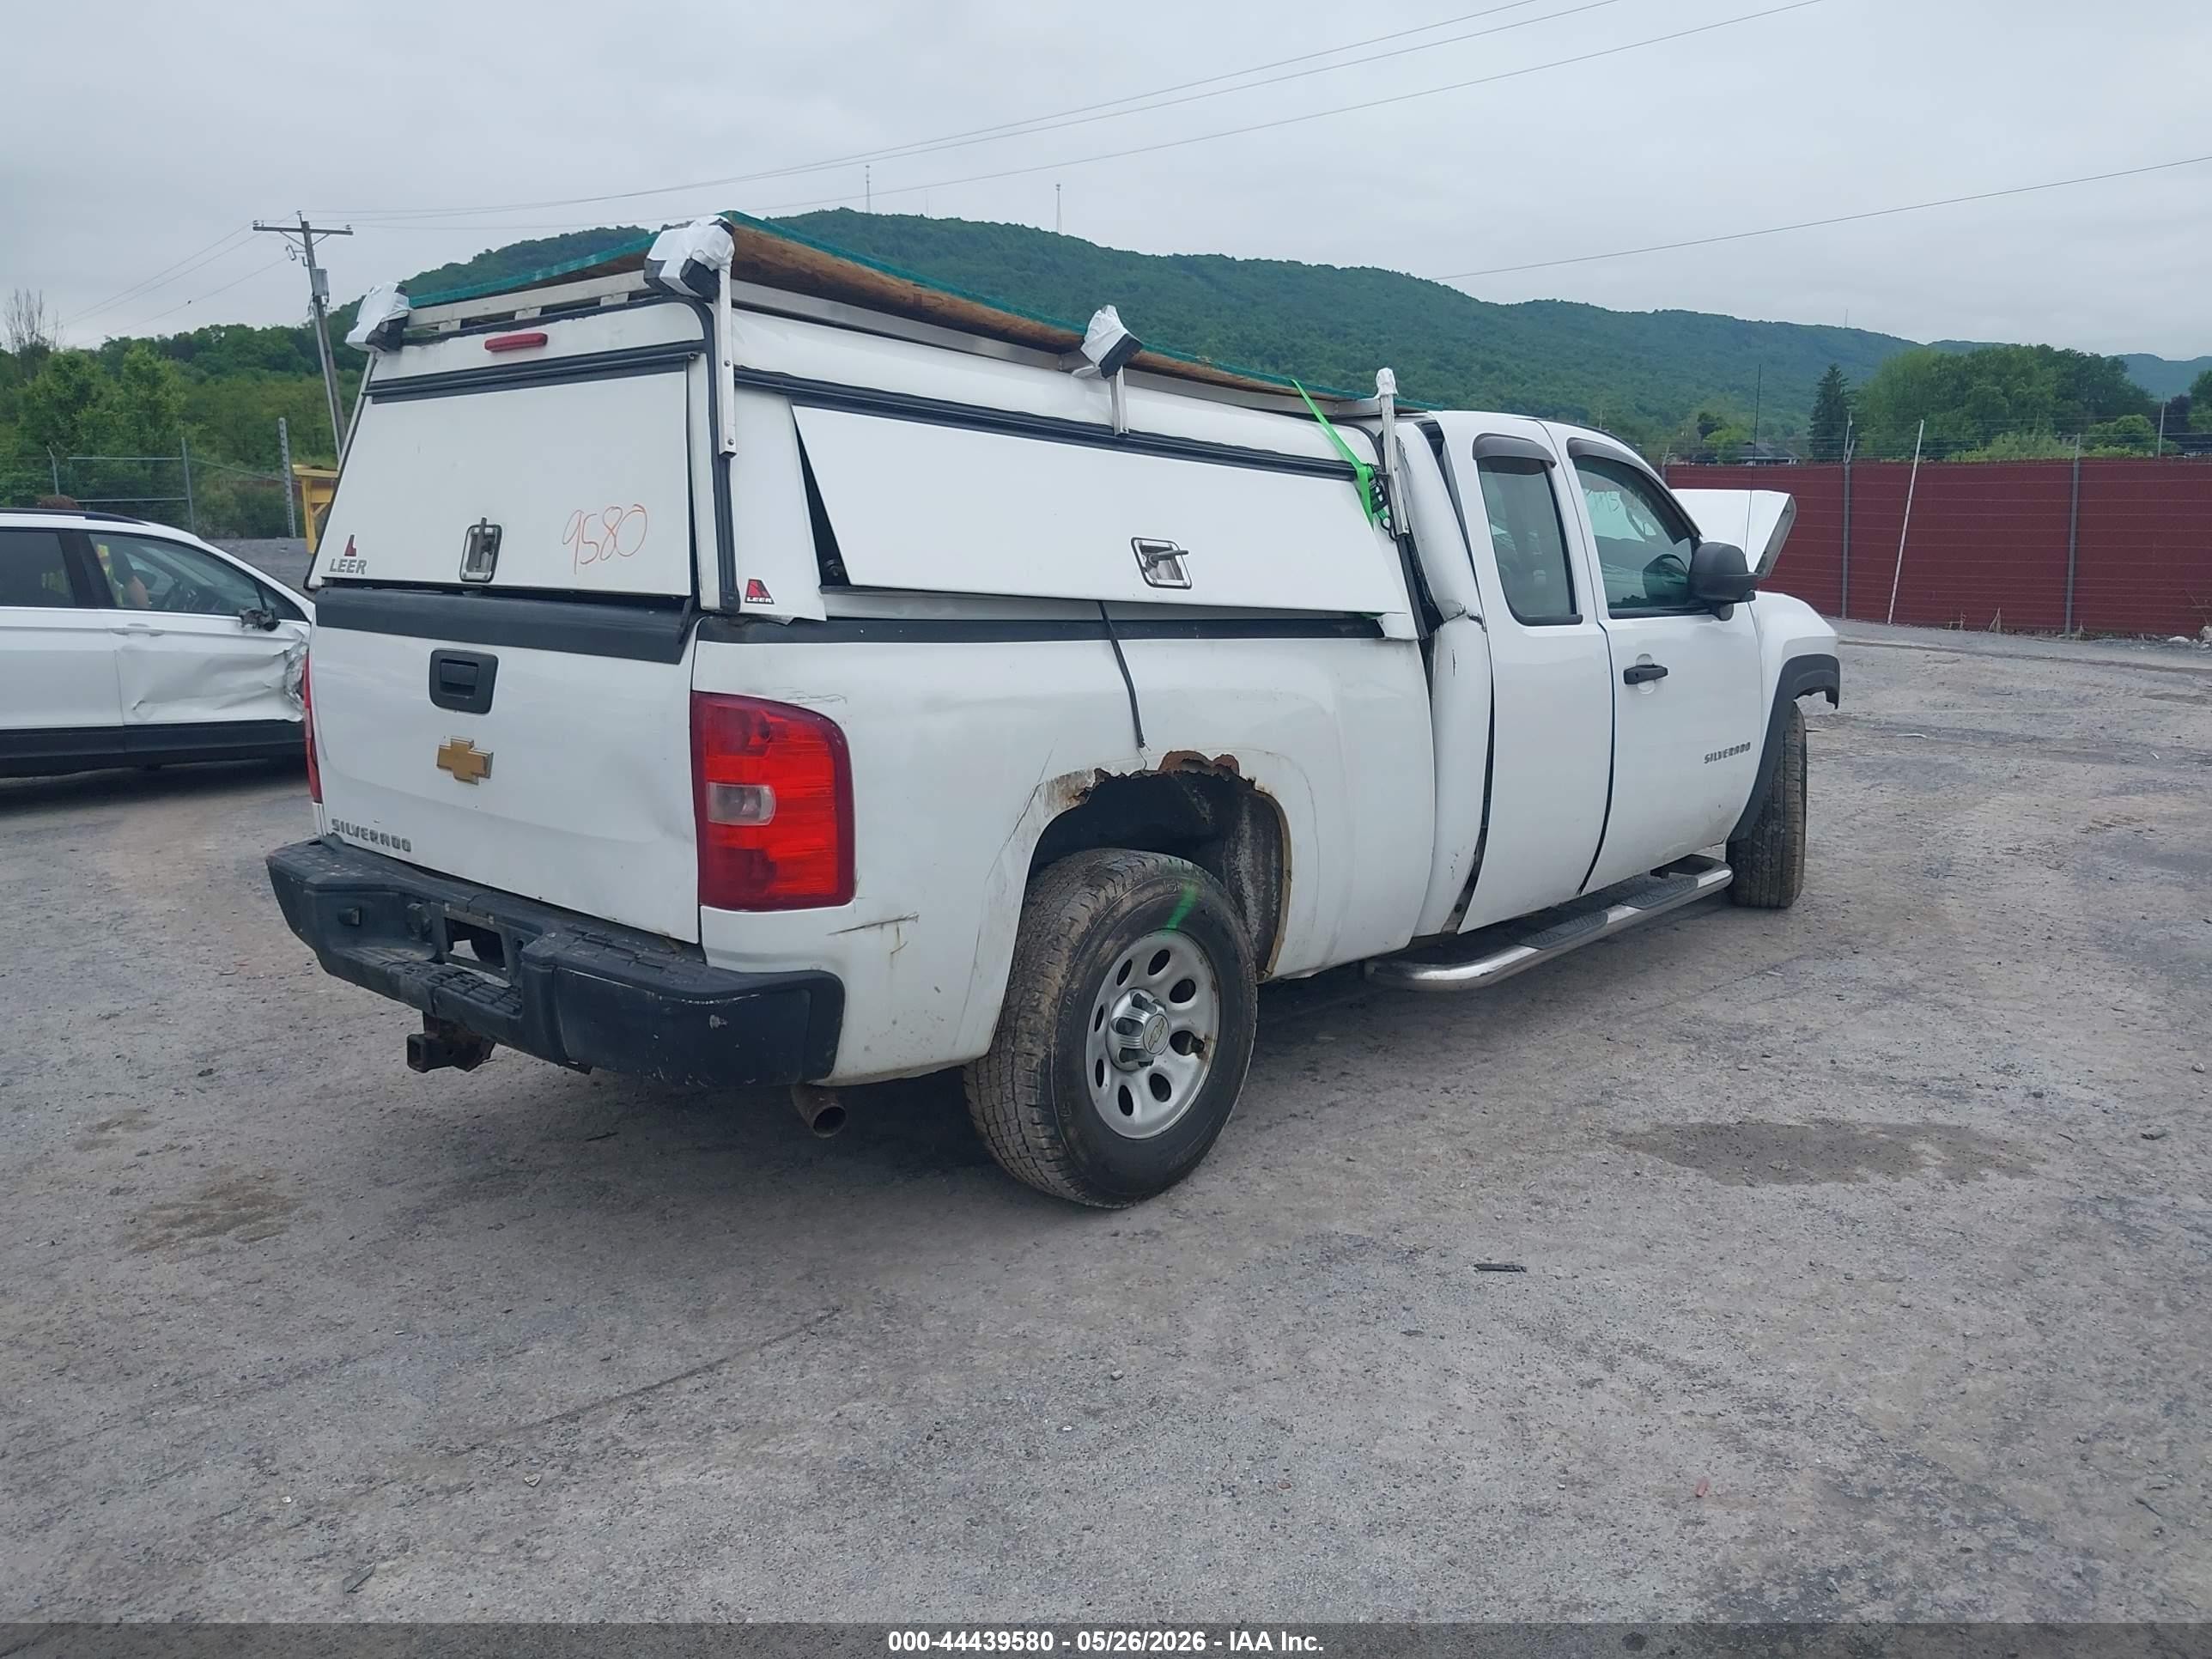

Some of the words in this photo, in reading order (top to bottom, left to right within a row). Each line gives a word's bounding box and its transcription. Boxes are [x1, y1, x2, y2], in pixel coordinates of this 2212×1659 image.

[562, 504, 647, 575] 9580
[329, 558, 368, 575] LEER
[1704, 741, 1751, 764] SILVERADO
[331, 817, 412, 853] SILVERADO
